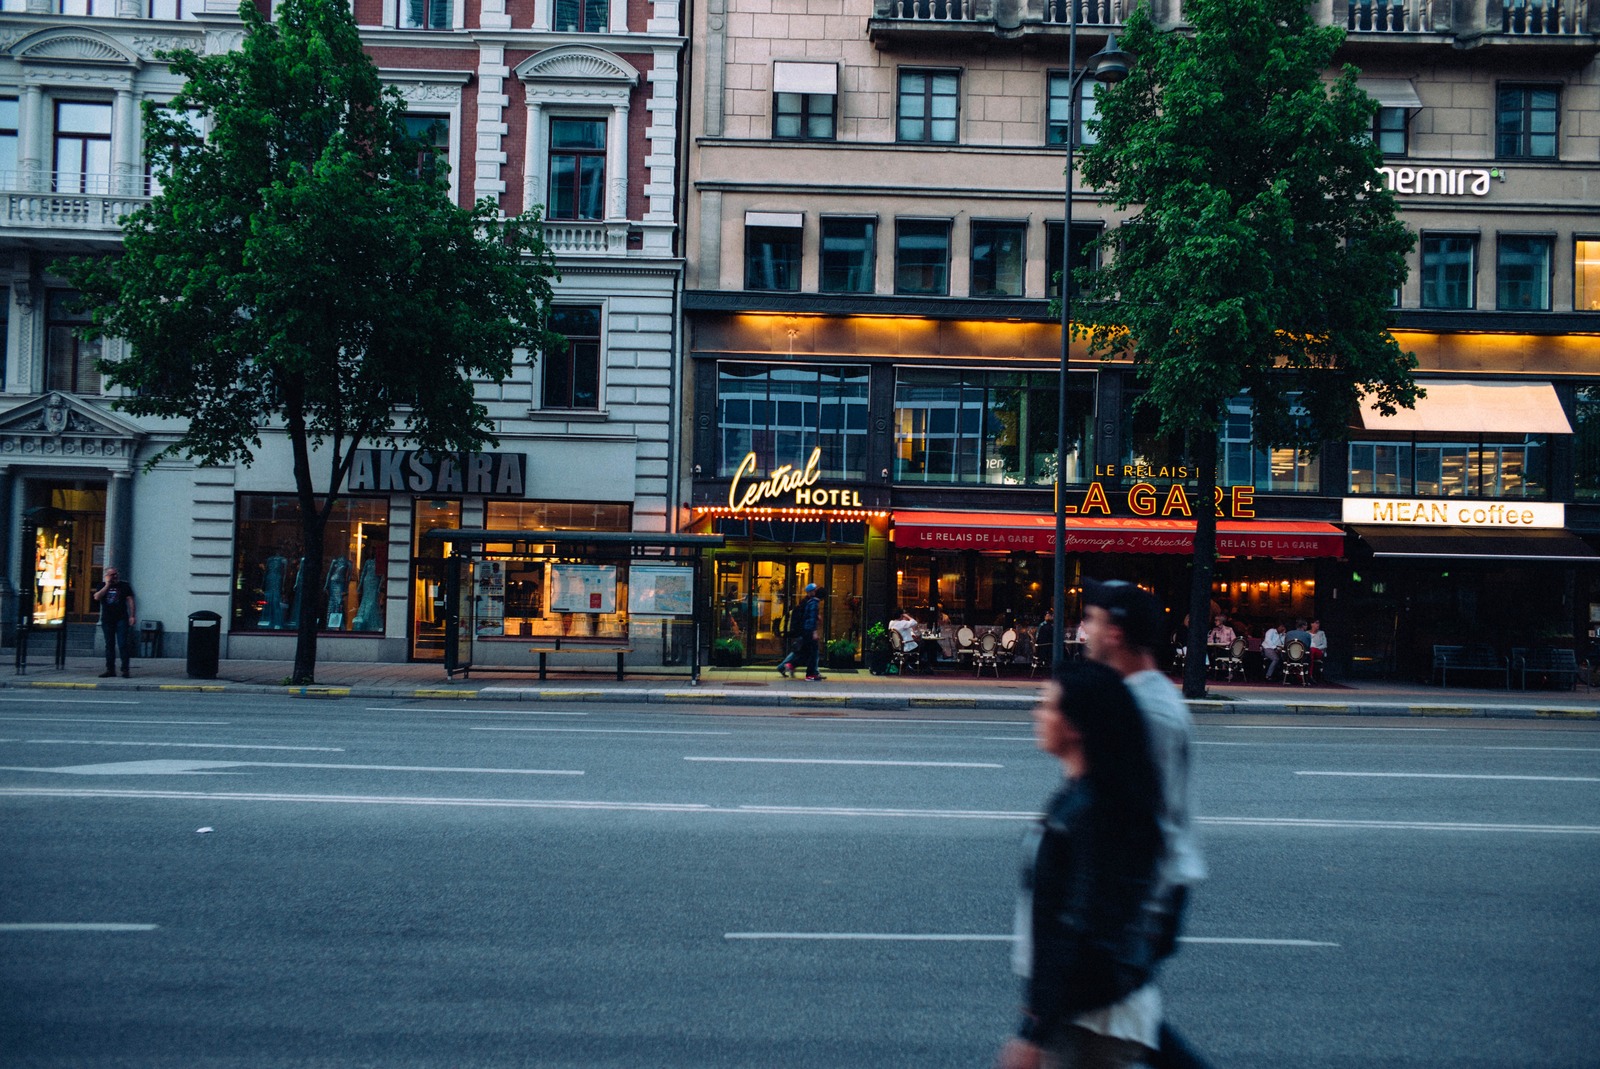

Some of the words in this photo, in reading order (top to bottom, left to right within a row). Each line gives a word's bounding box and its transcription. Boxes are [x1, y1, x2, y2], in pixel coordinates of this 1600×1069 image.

[350, 450, 523, 494] AKSARA
[729, 446, 822, 511] Central
[1095, 465, 1115, 476] LE
[1123, 465, 1187, 478] RELAIS
[796, 488, 862, 507] HOTEL
[1373, 502, 1448, 523] MEAN
[1458, 504, 1535, 524] coffee
[920, 532, 933, 541] LE
[936, 533, 972, 542] RELAIS
[976, 534, 989, 542] DE
[992, 535, 1005, 543] LA
[1008, 535, 1035, 544] GARE
[1220, 540, 1257, 548] RELAIS
[1260, 540, 1273, 548] DE
[1277, 541, 1289, 549] LA
[1292, 541, 1319, 550] GARE
